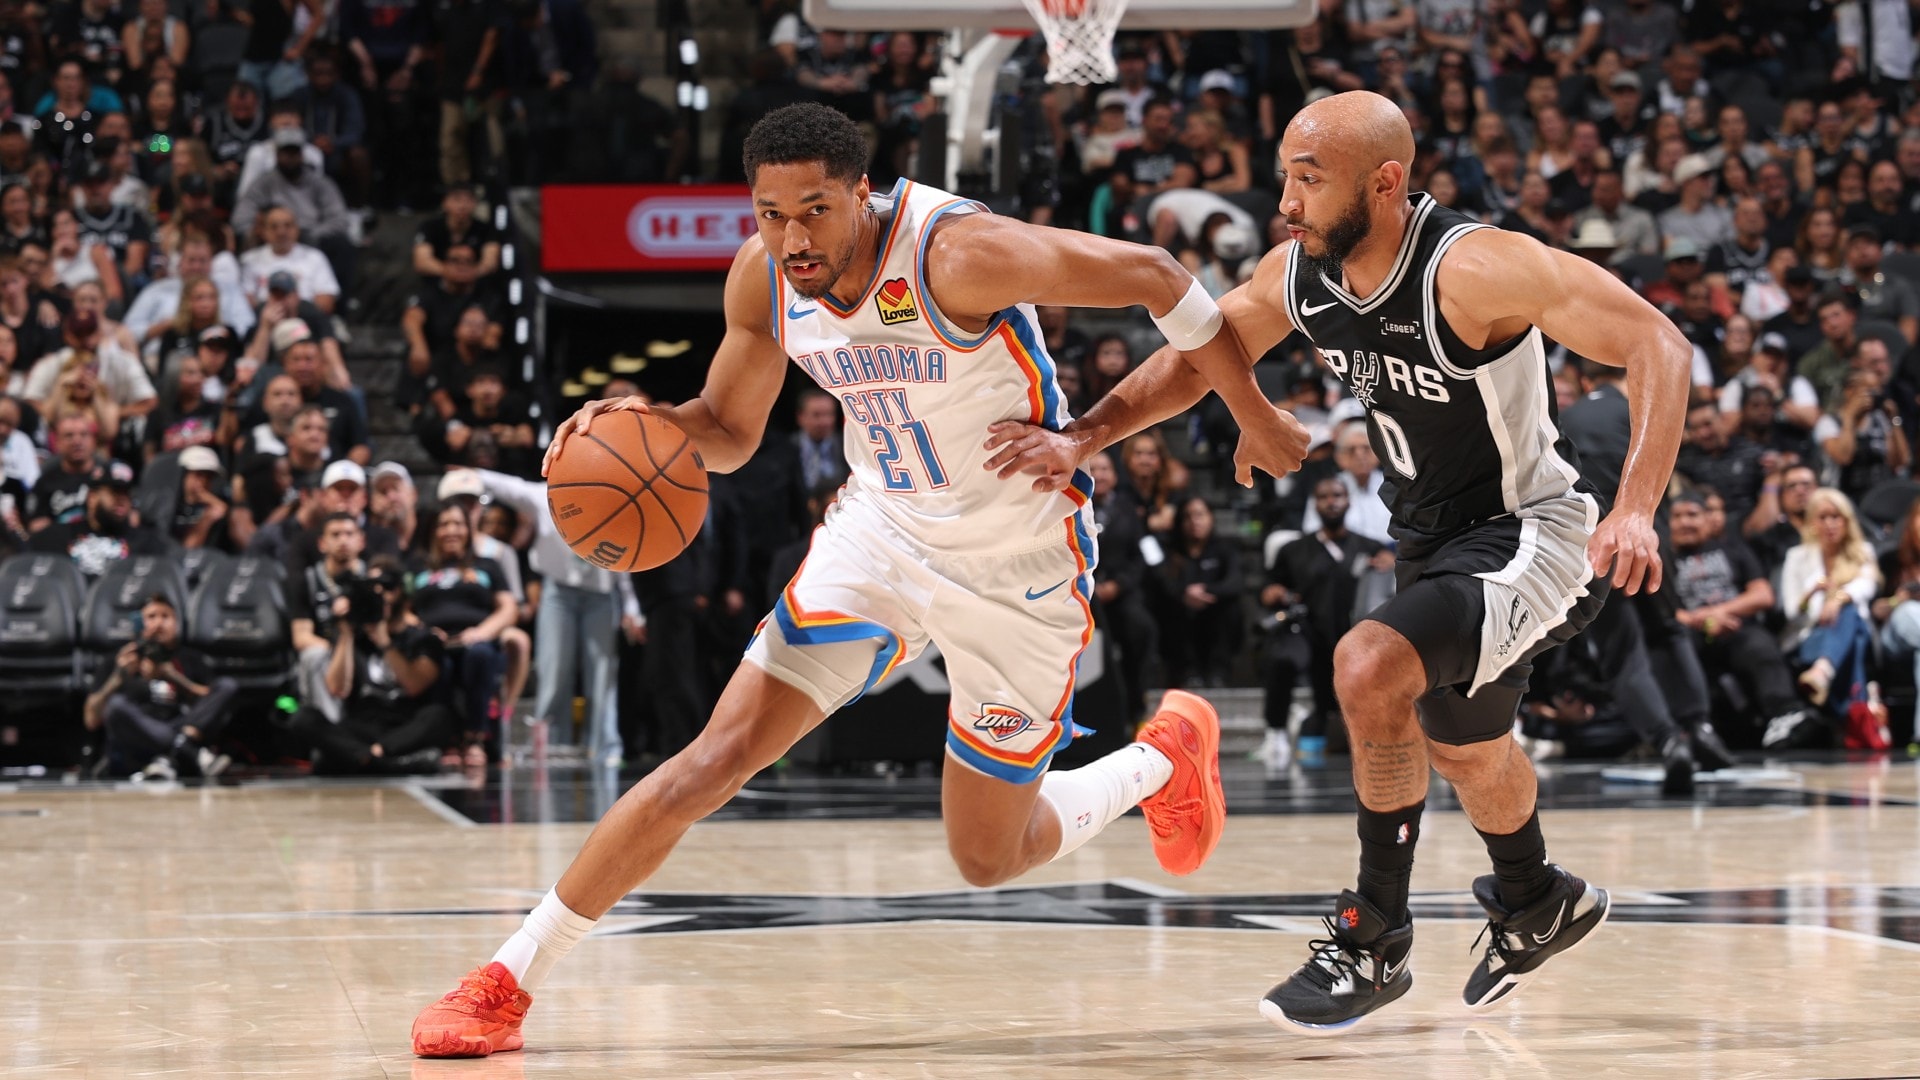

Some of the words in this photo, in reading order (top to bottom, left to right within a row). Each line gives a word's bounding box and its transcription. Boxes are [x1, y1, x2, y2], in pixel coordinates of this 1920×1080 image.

[1385, 322, 1415, 334] LEDGER
[798, 344, 946, 388] KLAHOMA
[841, 388, 915, 425] CITY
[867, 420, 950, 493] 21
[1371, 409, 1417, 480] 0
[974, 713, 1022, 729] OKC
